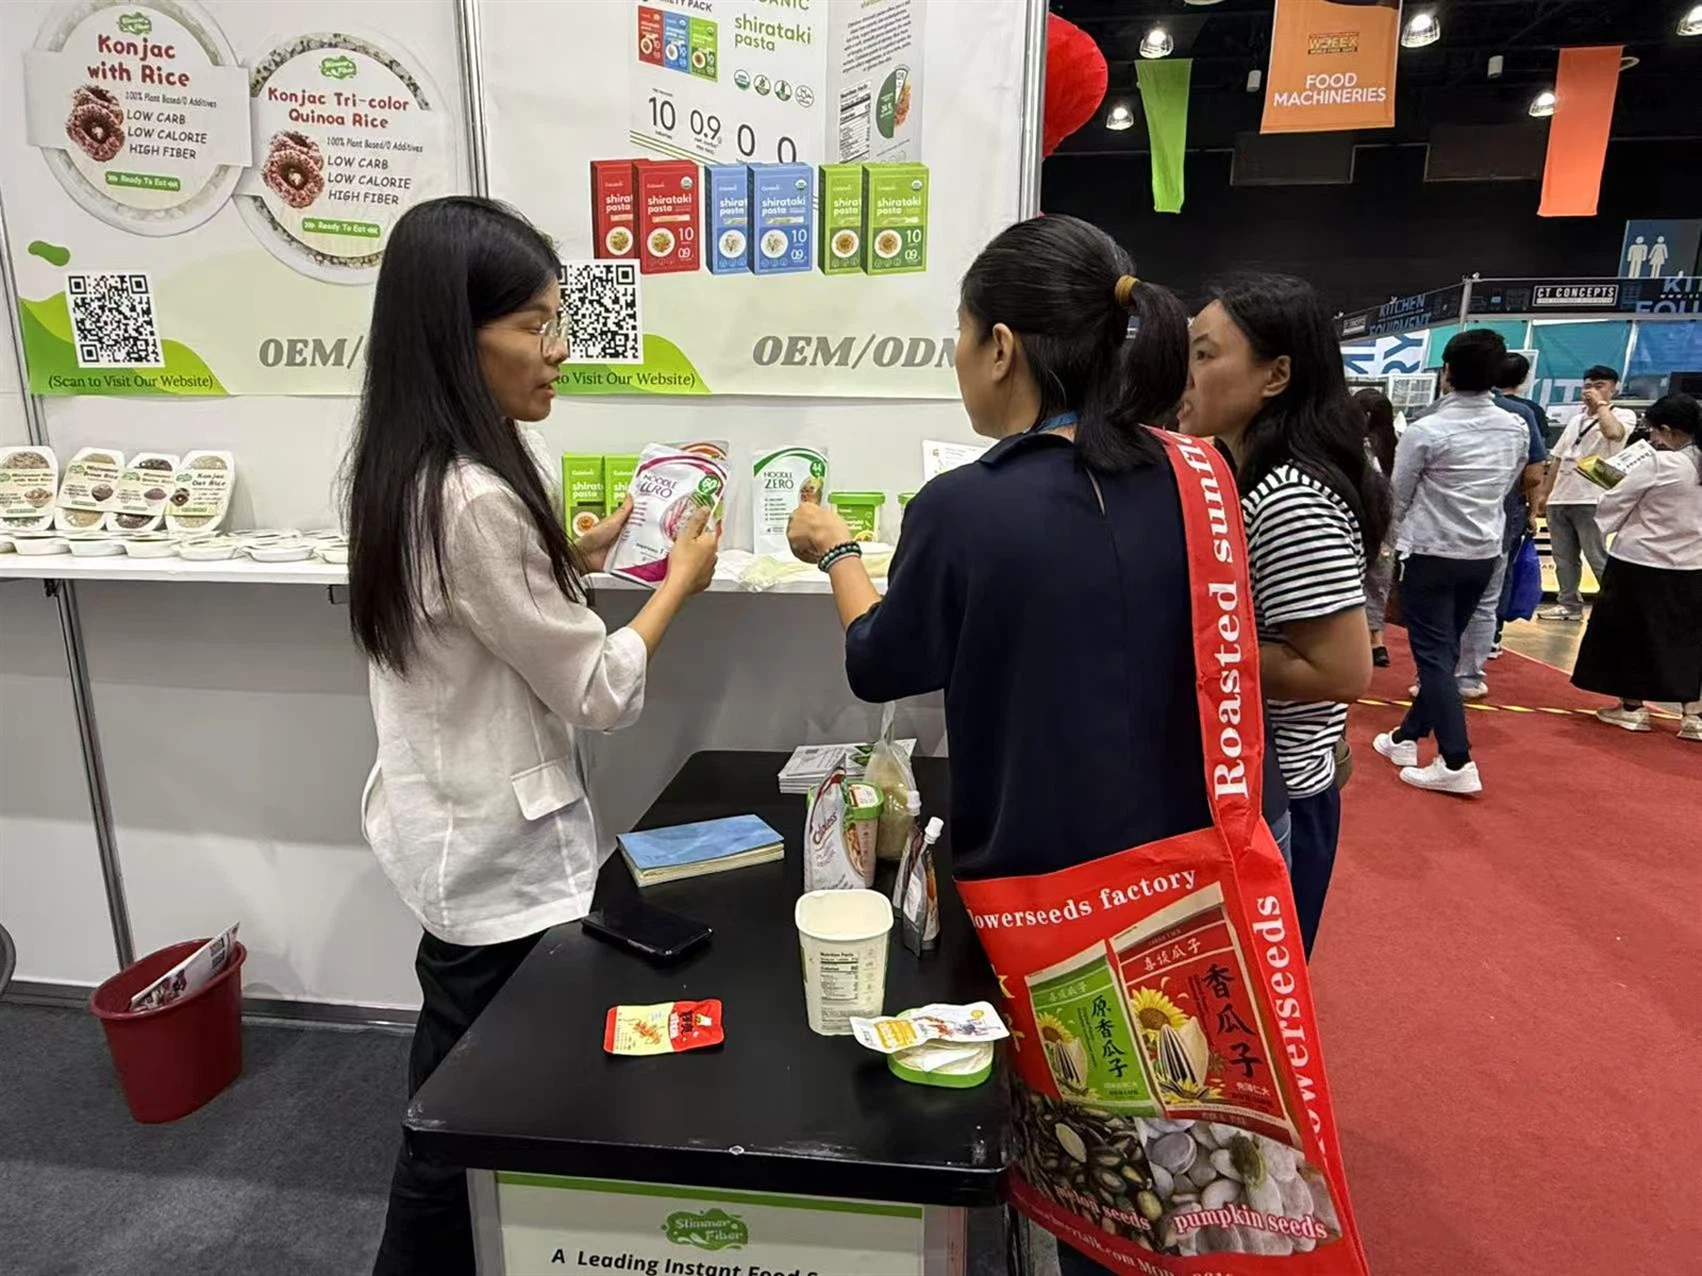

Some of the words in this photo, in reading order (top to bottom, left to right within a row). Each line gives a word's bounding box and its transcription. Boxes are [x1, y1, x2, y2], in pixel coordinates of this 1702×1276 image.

[688, 0, 712, 12] PACK
[735, 14, 811, 45] shirataki
[98, 34, 176, 61] Konjac
[735, 33, 775, 52] pasta
[87, 61, 131, 82] with
[141, 65, 190, 87] Rice
[1305, 73, 1357, 89] FOOD
[268, 87, 327, 107] Konjac
[334, 92, 410, 111] Tri-color
[1273, 87, 1387, 107] MACHINERIES
[127, 109, 153, 122] LOW
[157, 112, 186, 125] CARB
[288, 108, 345, 126] Quinoa
[352, 113, 389, 129] Rice
[648, 96, 676, 131] 10
[127, 127, 154, 139] LOW
[157, 130, 208, 145] CALORIE
[737, 124, 755, 157] 0
[129, 144, 160, 156] HIGH
[163, 147, 196, 160] FIBER
[327, 155, 355, 168] LOW
[358, 158, 389, 170] CARB
[120, 173, 142, 185] Ready
[327, 173, 355, 185] LOW
[358, 175, 411, 189] CALORIE
[328, 190, 360, 201] HIGH
[363, 193, 399, 205] FIBER
[647, 193, 691, 205] shirataki
[762, 196, 806, 207] shirataki
[877, 196, 921, 207] shirataki
[606, 203, 631, 215] pasta
[647, 205, 673, 216] pasta
[720, 206, 744, 217] pasta
[762, 206, 787, 218] pasta
[318, 221, 340, 233] Ready
[679, 227, 694, 241] 10
[791, 229, 807, 243] 10
[906, 229, 921, 243] 10
[1537, 288, 1551, 298] CT
[1556, 287, 1614, 298] CONCEPTS
[1379, 294, 1425, 317] KITCHEN
[48, 375, 85, 389] (Scan
[88, 376, 101, 387] to
[103, 375, 131, 388] Visit
[134, 375, 158, 388] Our
[160, 375, 213, 390] Website)
[573, 372, 601, 385] Visit
[606, 372, 633, 386] Our
[636, 373, 696, 388] Website)
[765, 479, 794, 489] ZERO
[573, 490, 598, 500] pasta
[1208, 579, 1250, 800] Roasted
[1099, 869, 1196, 910] factory
[1202, 963, 1264, 1078] 香瓜子
[1092, 995, 1128, 1078] 原香瓜子
[1174, 1203, 1264, 1233] pumpkin
[1268, 1214, 1328, 1240] seeds
[551, 1249, 566, 1264] A
[578, 1251, 659, 1276] Leading
[664, 1258, 742, 1276] Instant
